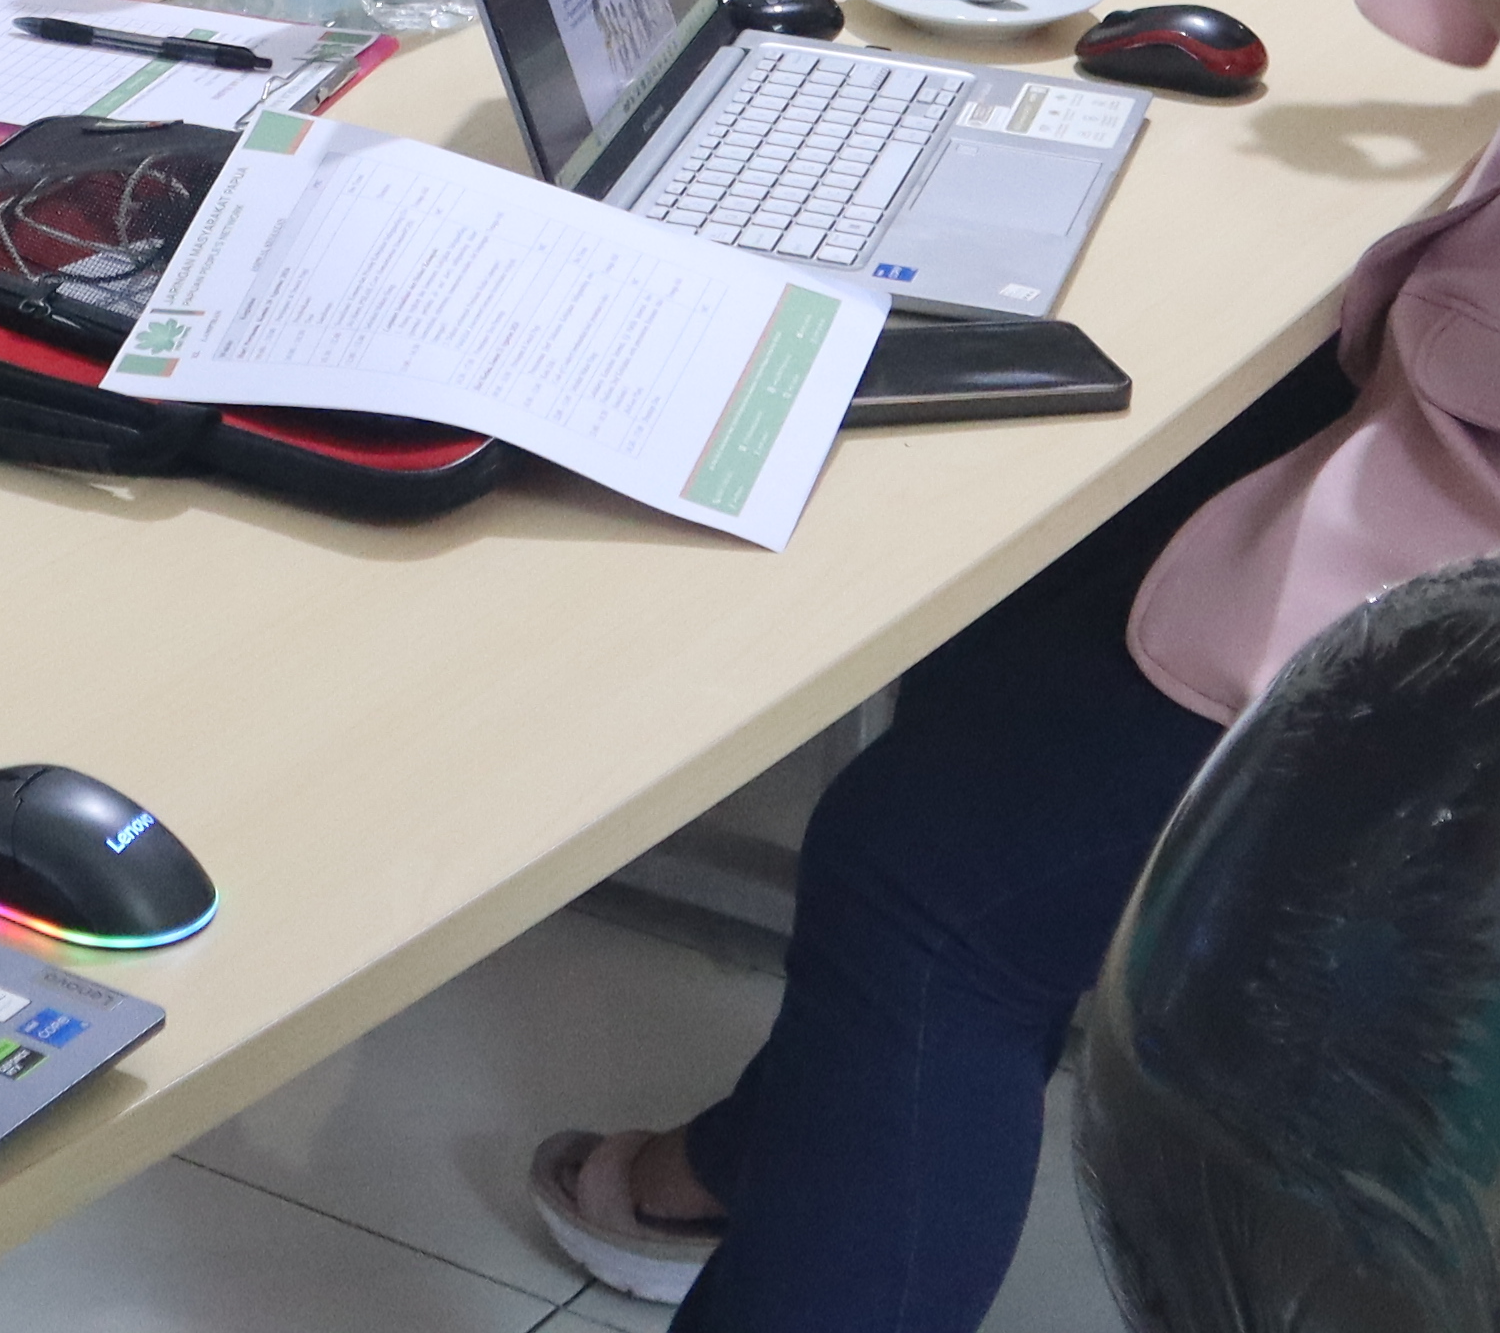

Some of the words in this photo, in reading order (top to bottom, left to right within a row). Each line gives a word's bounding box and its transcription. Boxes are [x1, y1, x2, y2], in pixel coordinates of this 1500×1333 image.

[164, 255, 196, 305] JARINGAN
[190, 196, 232, 259] MASYARAKAT
[225, 166, 249, 201] PAPUA
[105, 812, 156, 854] Lenovo
